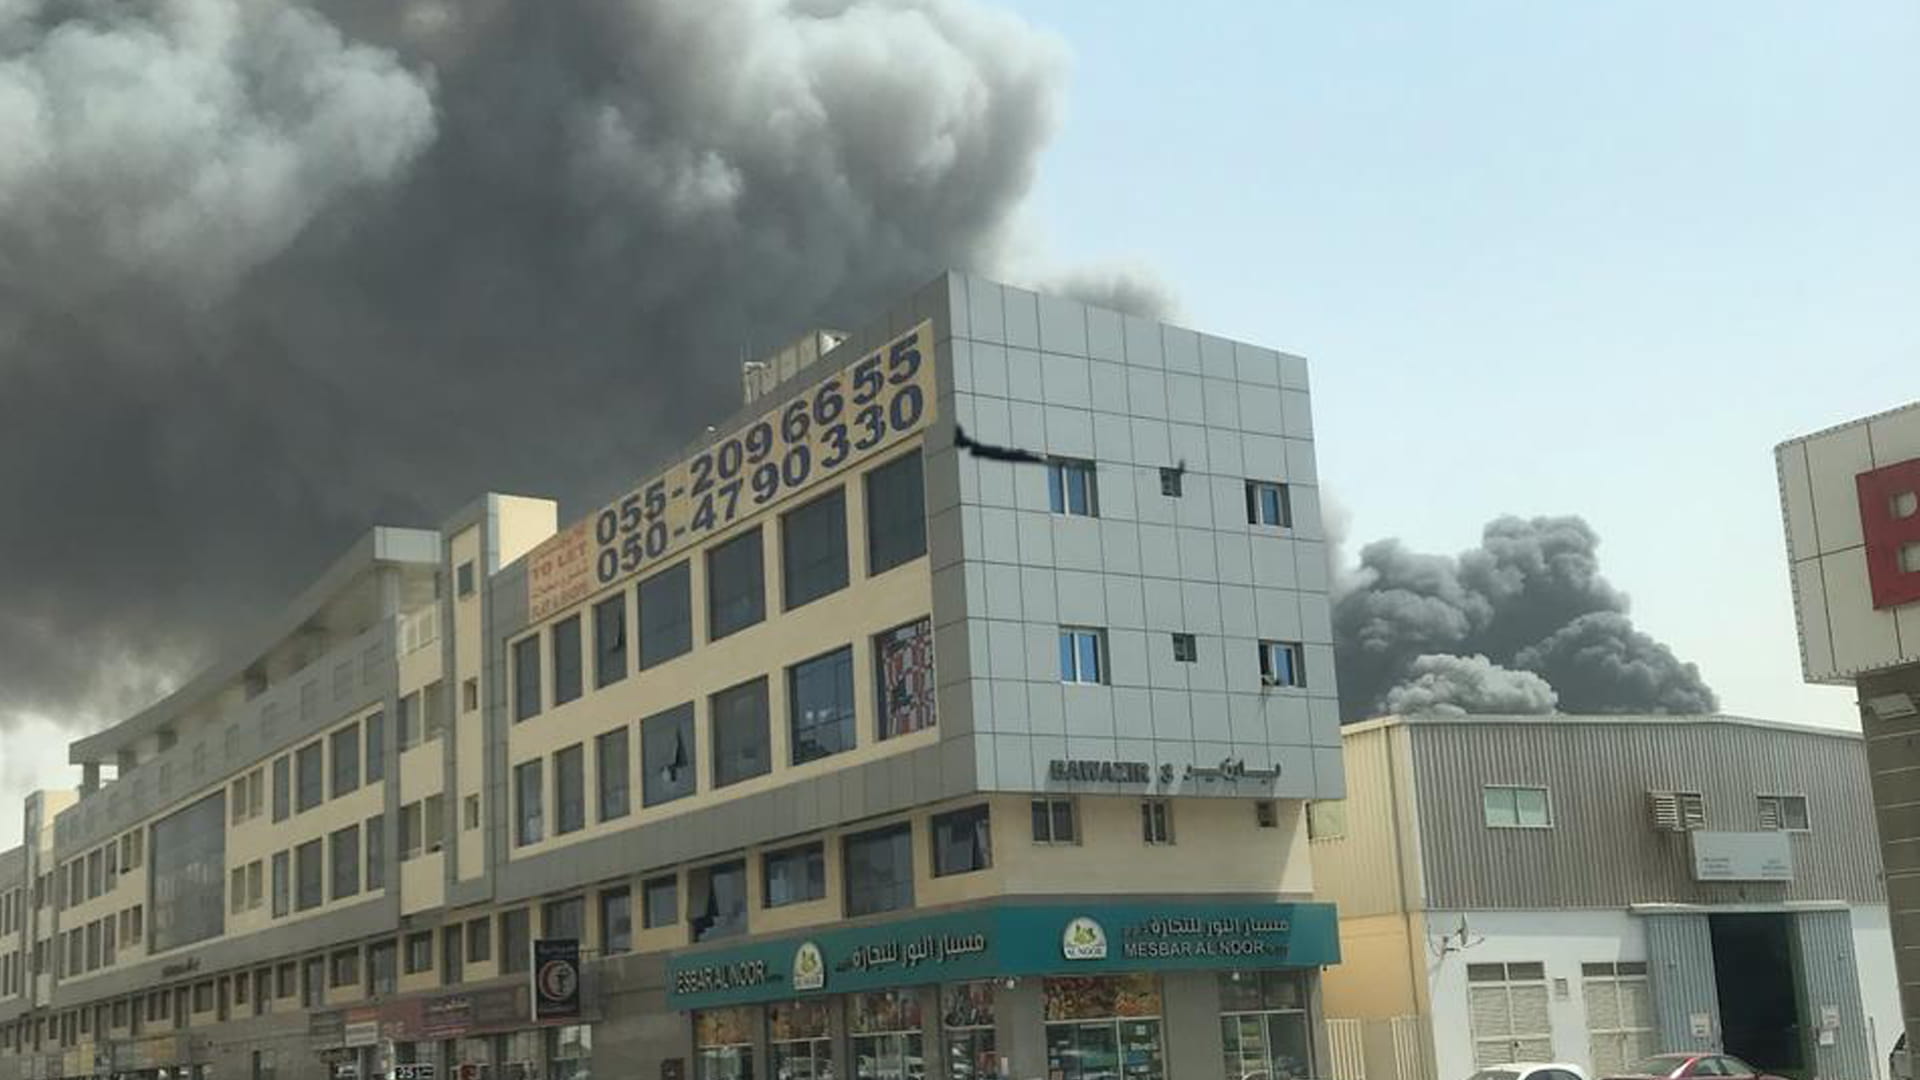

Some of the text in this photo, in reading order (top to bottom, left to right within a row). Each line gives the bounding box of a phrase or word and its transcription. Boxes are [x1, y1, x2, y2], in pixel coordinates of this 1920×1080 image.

[597, 333, 921, 546] 055-2096655
[597, 385, 923, 582] 050-4790330
[1124, 942, 1191, 957] MESBAR
[1194, 942, 1215, 955] AL
[1219, 939, 1264, 955] NOOR
